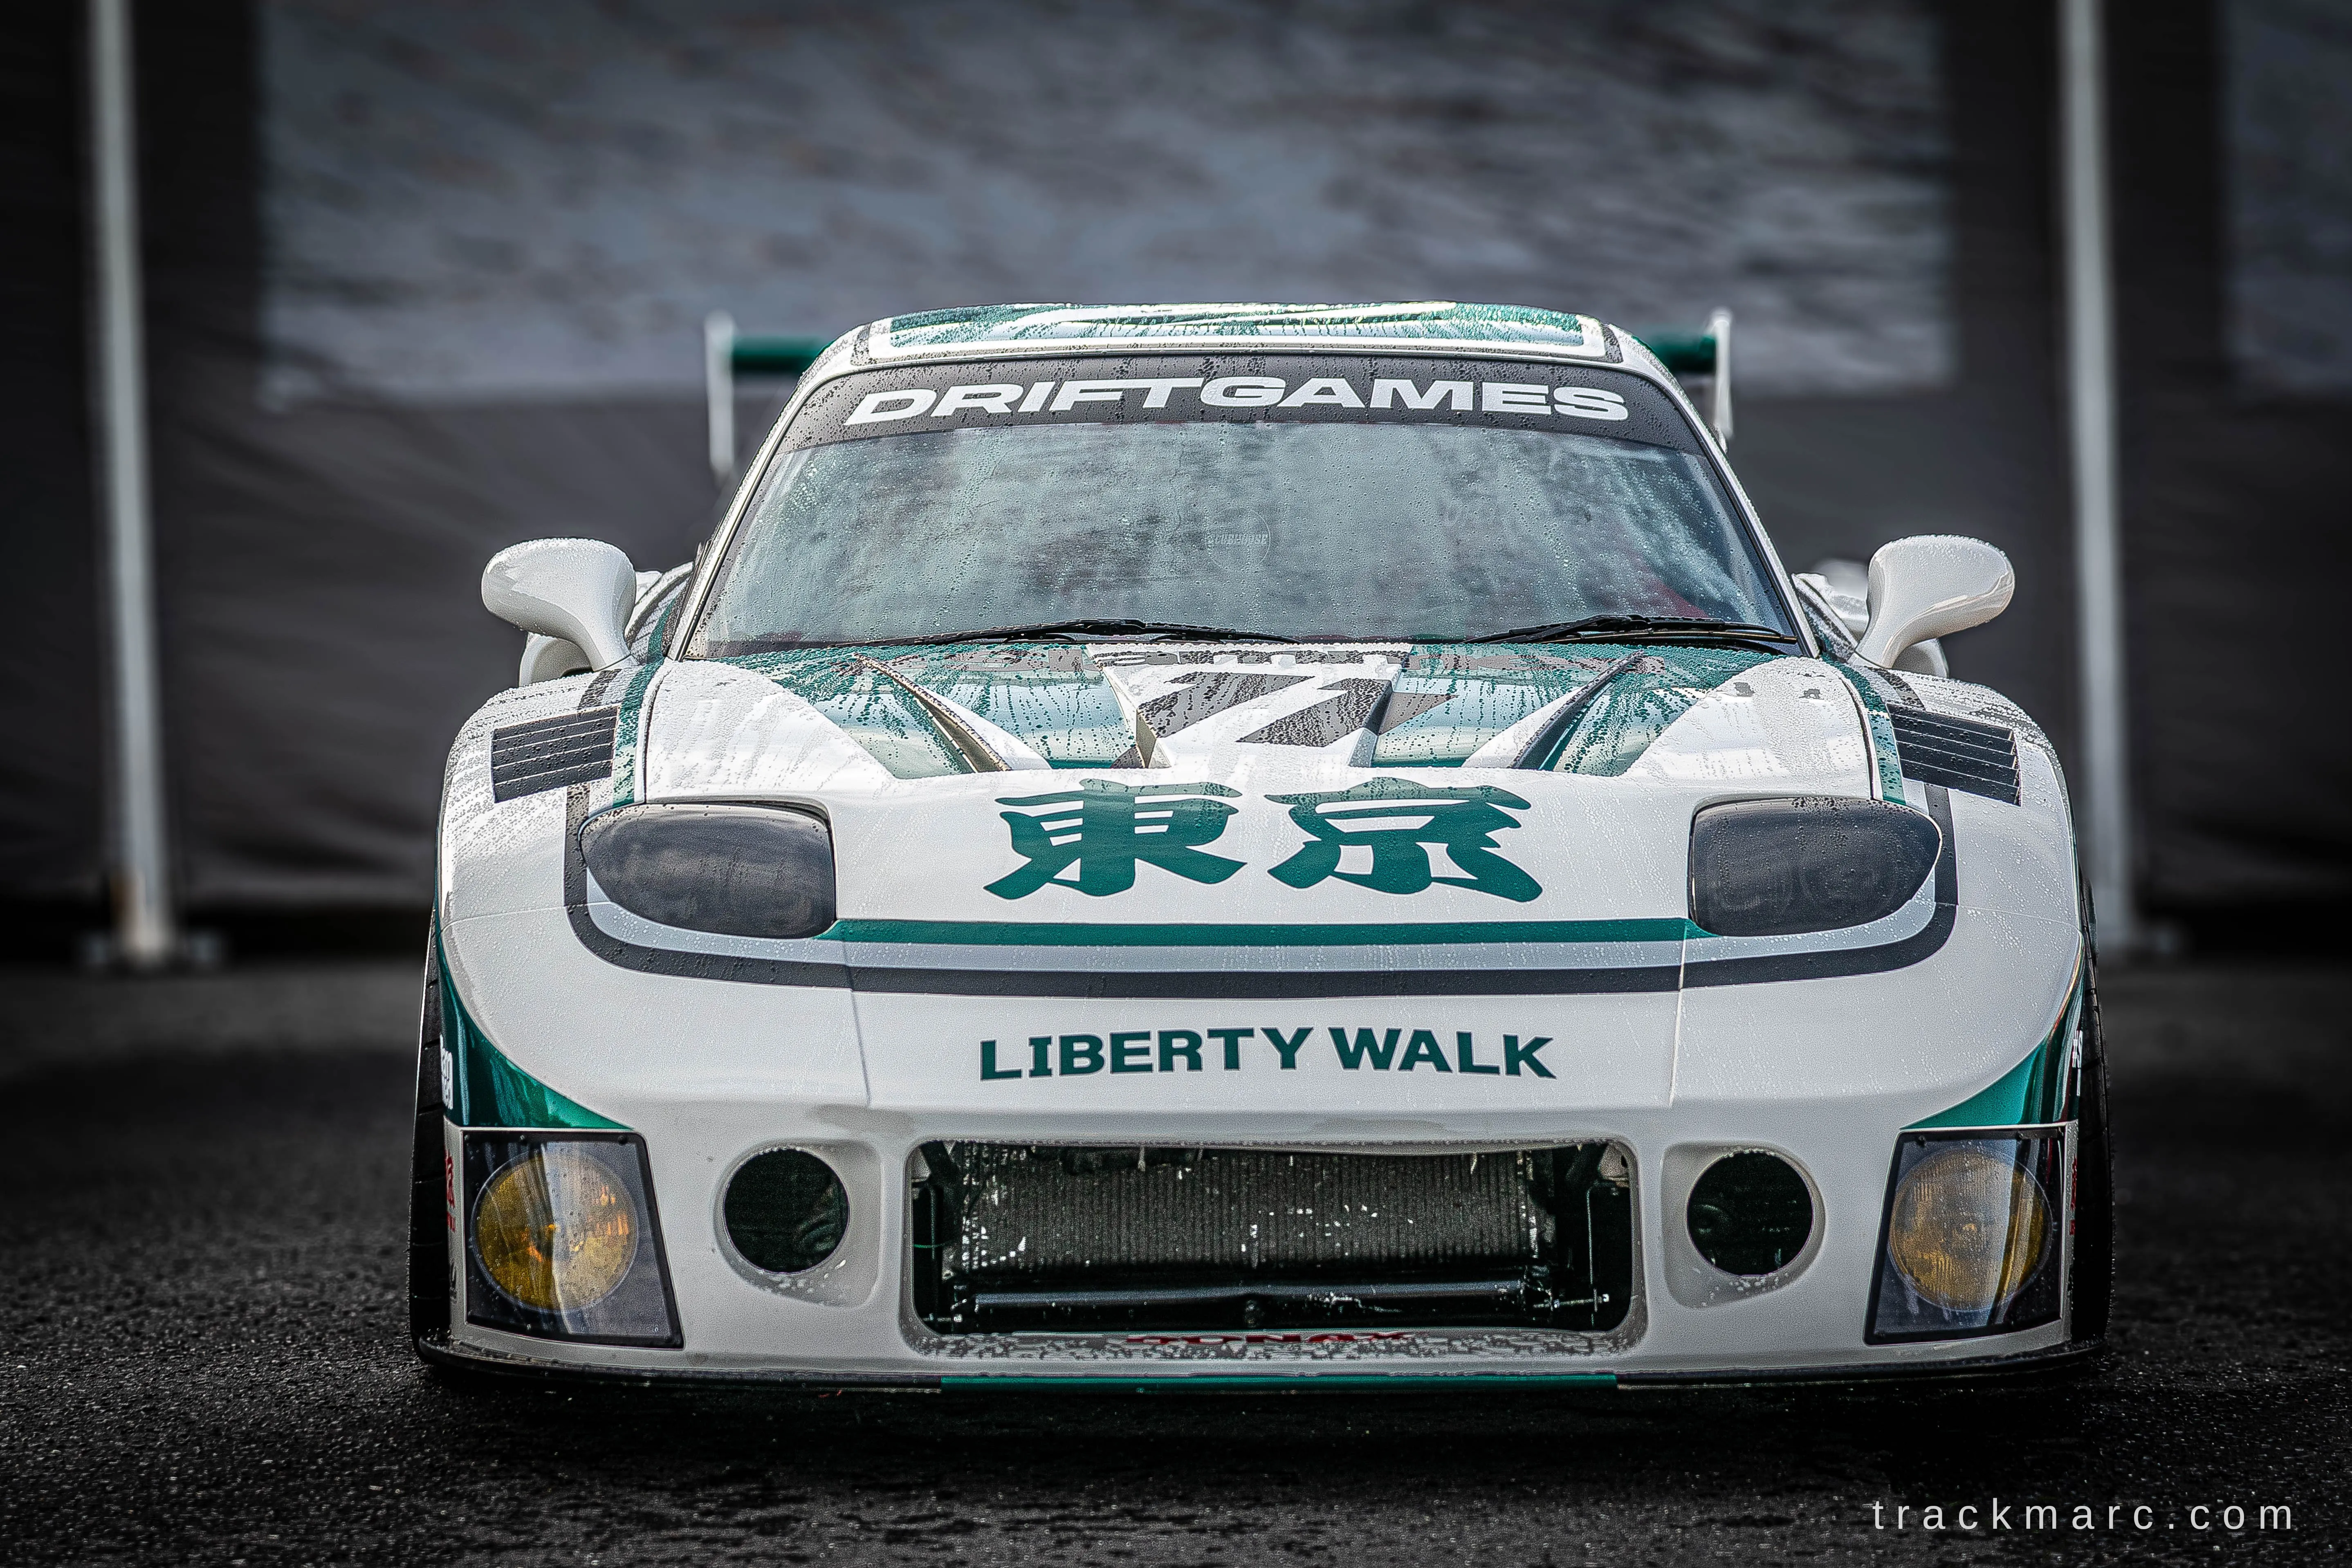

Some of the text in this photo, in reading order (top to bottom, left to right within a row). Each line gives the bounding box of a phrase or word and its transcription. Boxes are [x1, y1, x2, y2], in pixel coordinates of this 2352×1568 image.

[842, 376, 1628, 426] DRIFTGAMES
[983, 777, 1543, 902] 東京
[981, 1027, 1556, 1081] LIBERTY WALK
